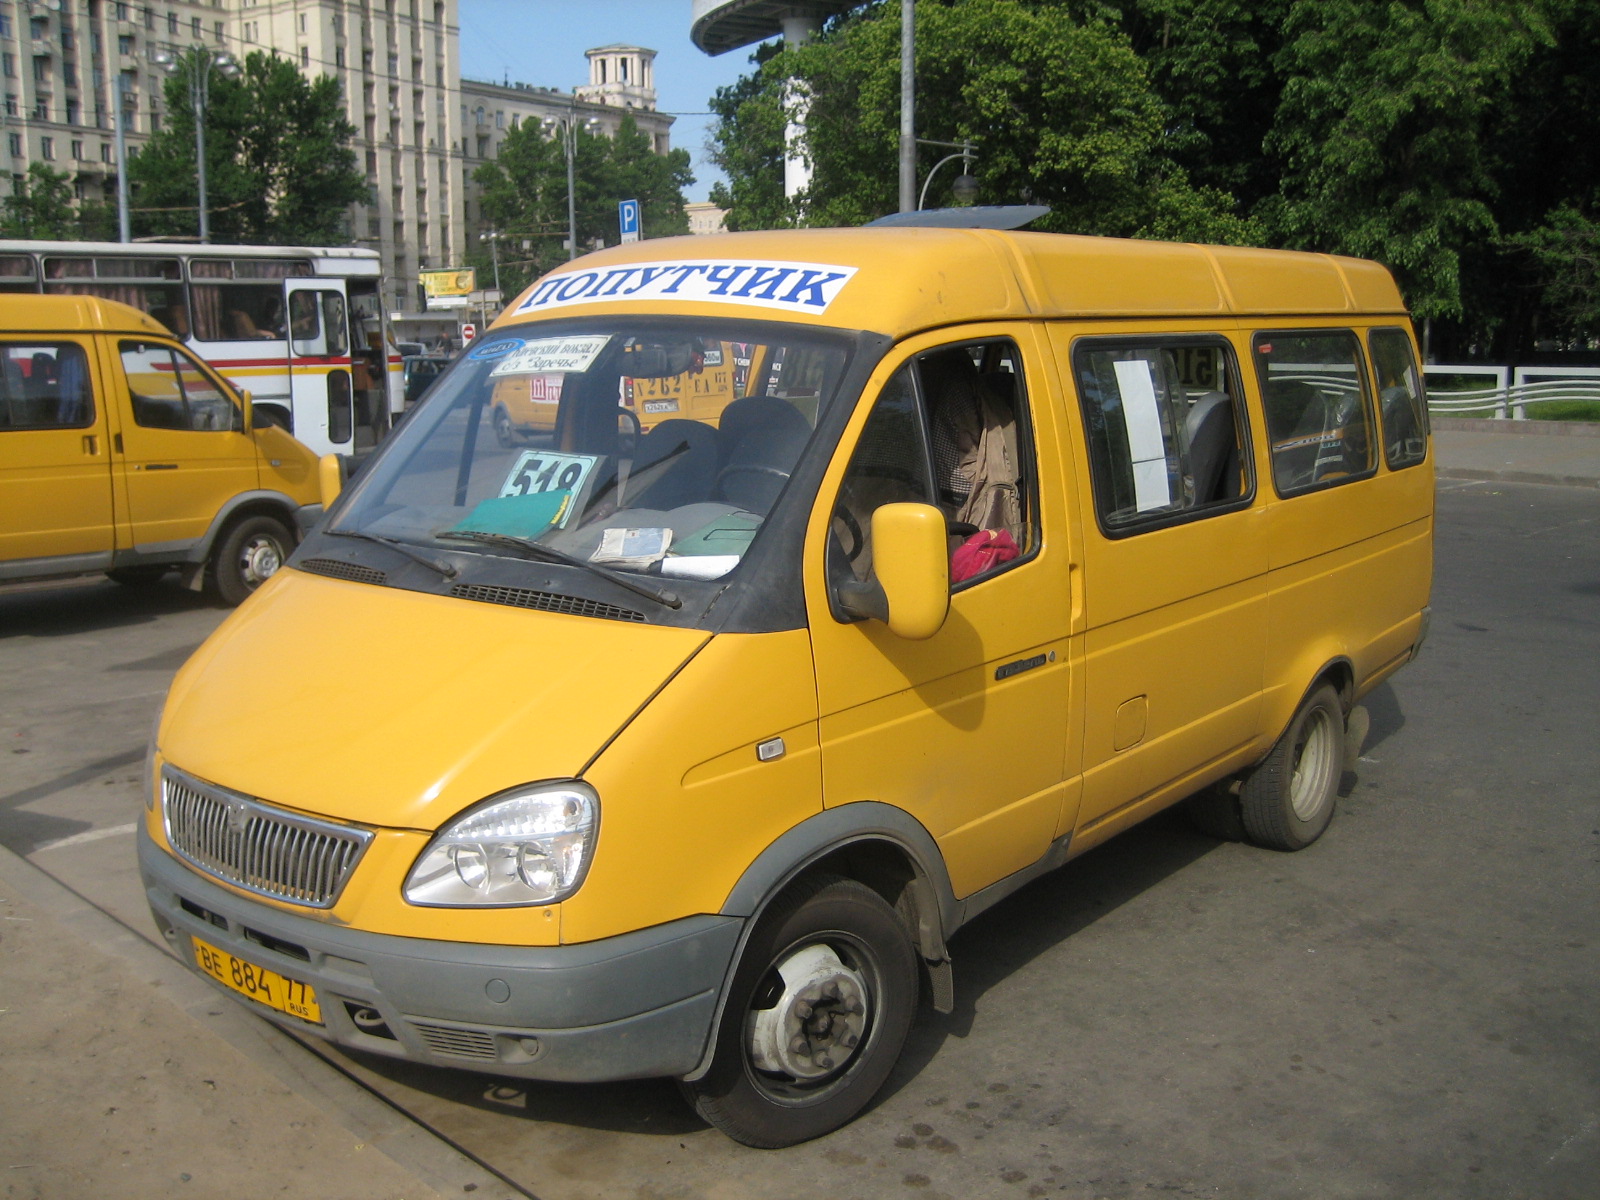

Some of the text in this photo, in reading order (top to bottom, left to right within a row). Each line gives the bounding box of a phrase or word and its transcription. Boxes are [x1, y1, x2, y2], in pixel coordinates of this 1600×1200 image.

[623, 204, 635, 231] P
[518, 263, 847, 308] ПОПУТЧИК
[200, 945, 305, 1004] ВЕ 884 77
[289, 1002, 310, 1016] RUS
